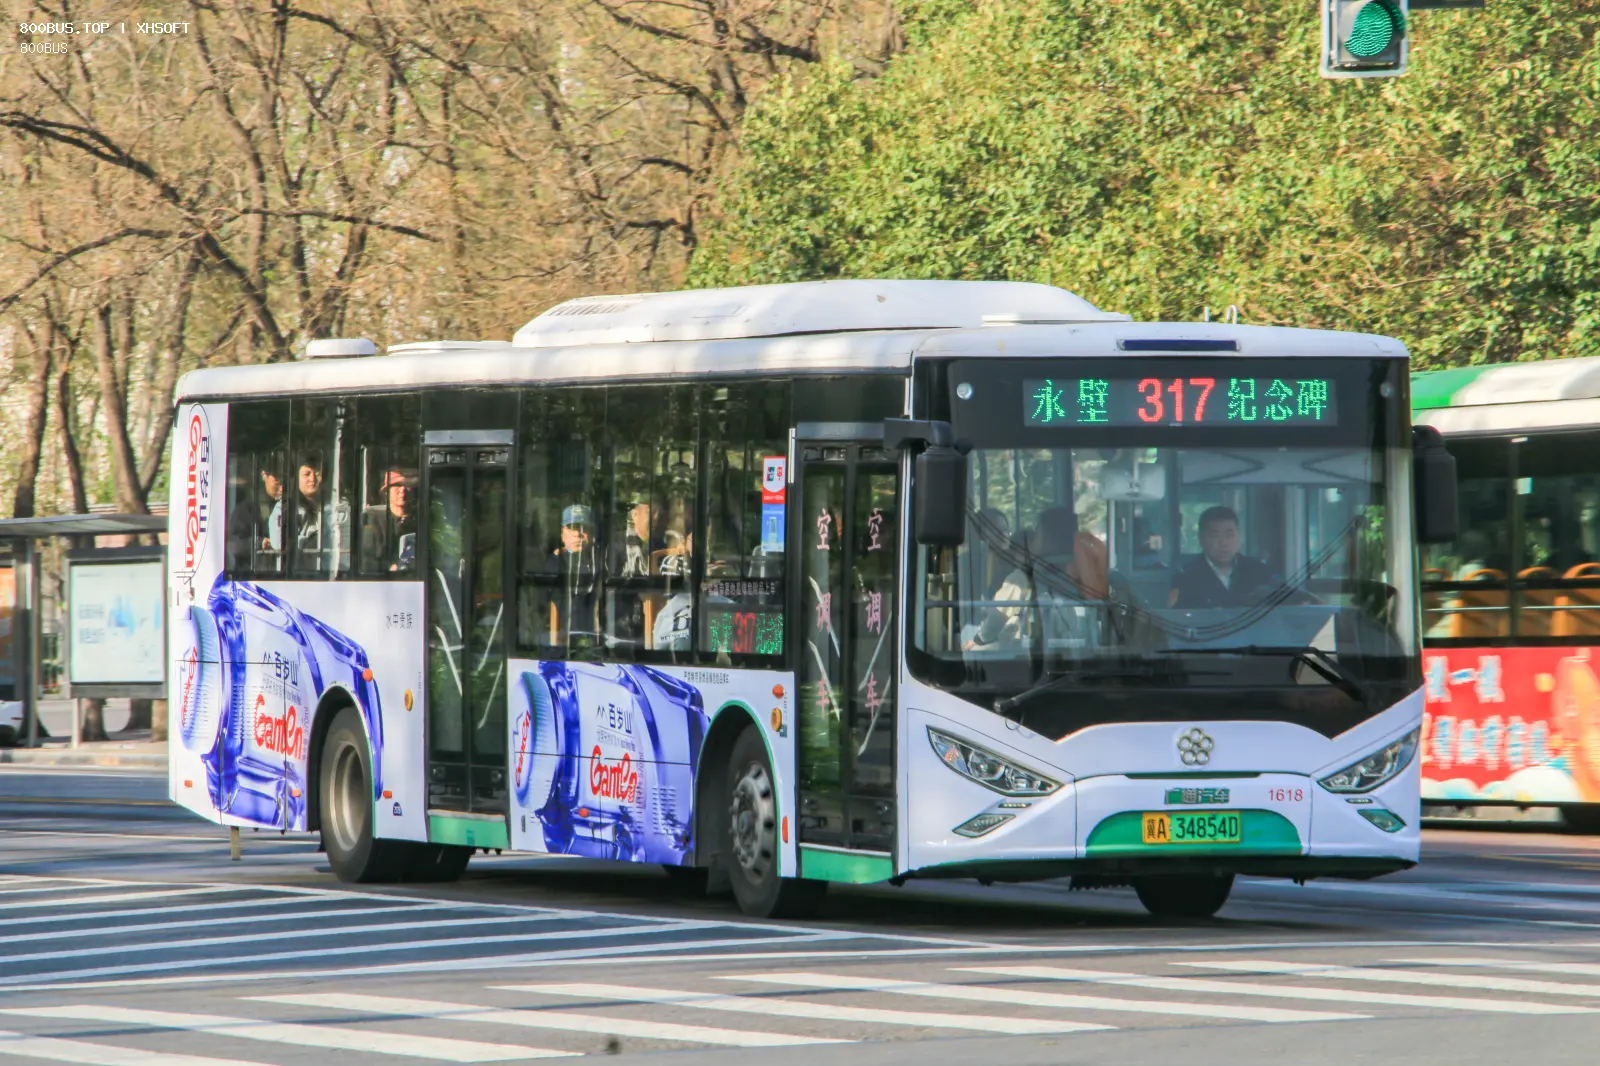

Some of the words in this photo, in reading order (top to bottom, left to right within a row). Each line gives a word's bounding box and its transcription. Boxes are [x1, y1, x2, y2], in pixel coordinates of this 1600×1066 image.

[1137, 377, 1216, 423] 317
[1227, 377, 1328, 422] 纪念碑
[385, 611, 413, 630] 水中贵族
[815, 507, 832, 721] 空调车
[864, 502, 884, 724] 空调车
[274, 650, 300, 687] 百岁山
[608, 702, 632, 734] 百岁山
[590, 744, 638, 803] Ganten
[1267, 788, 1304, 802] 1618
[1175, 816, 1239, 838] 34854D
